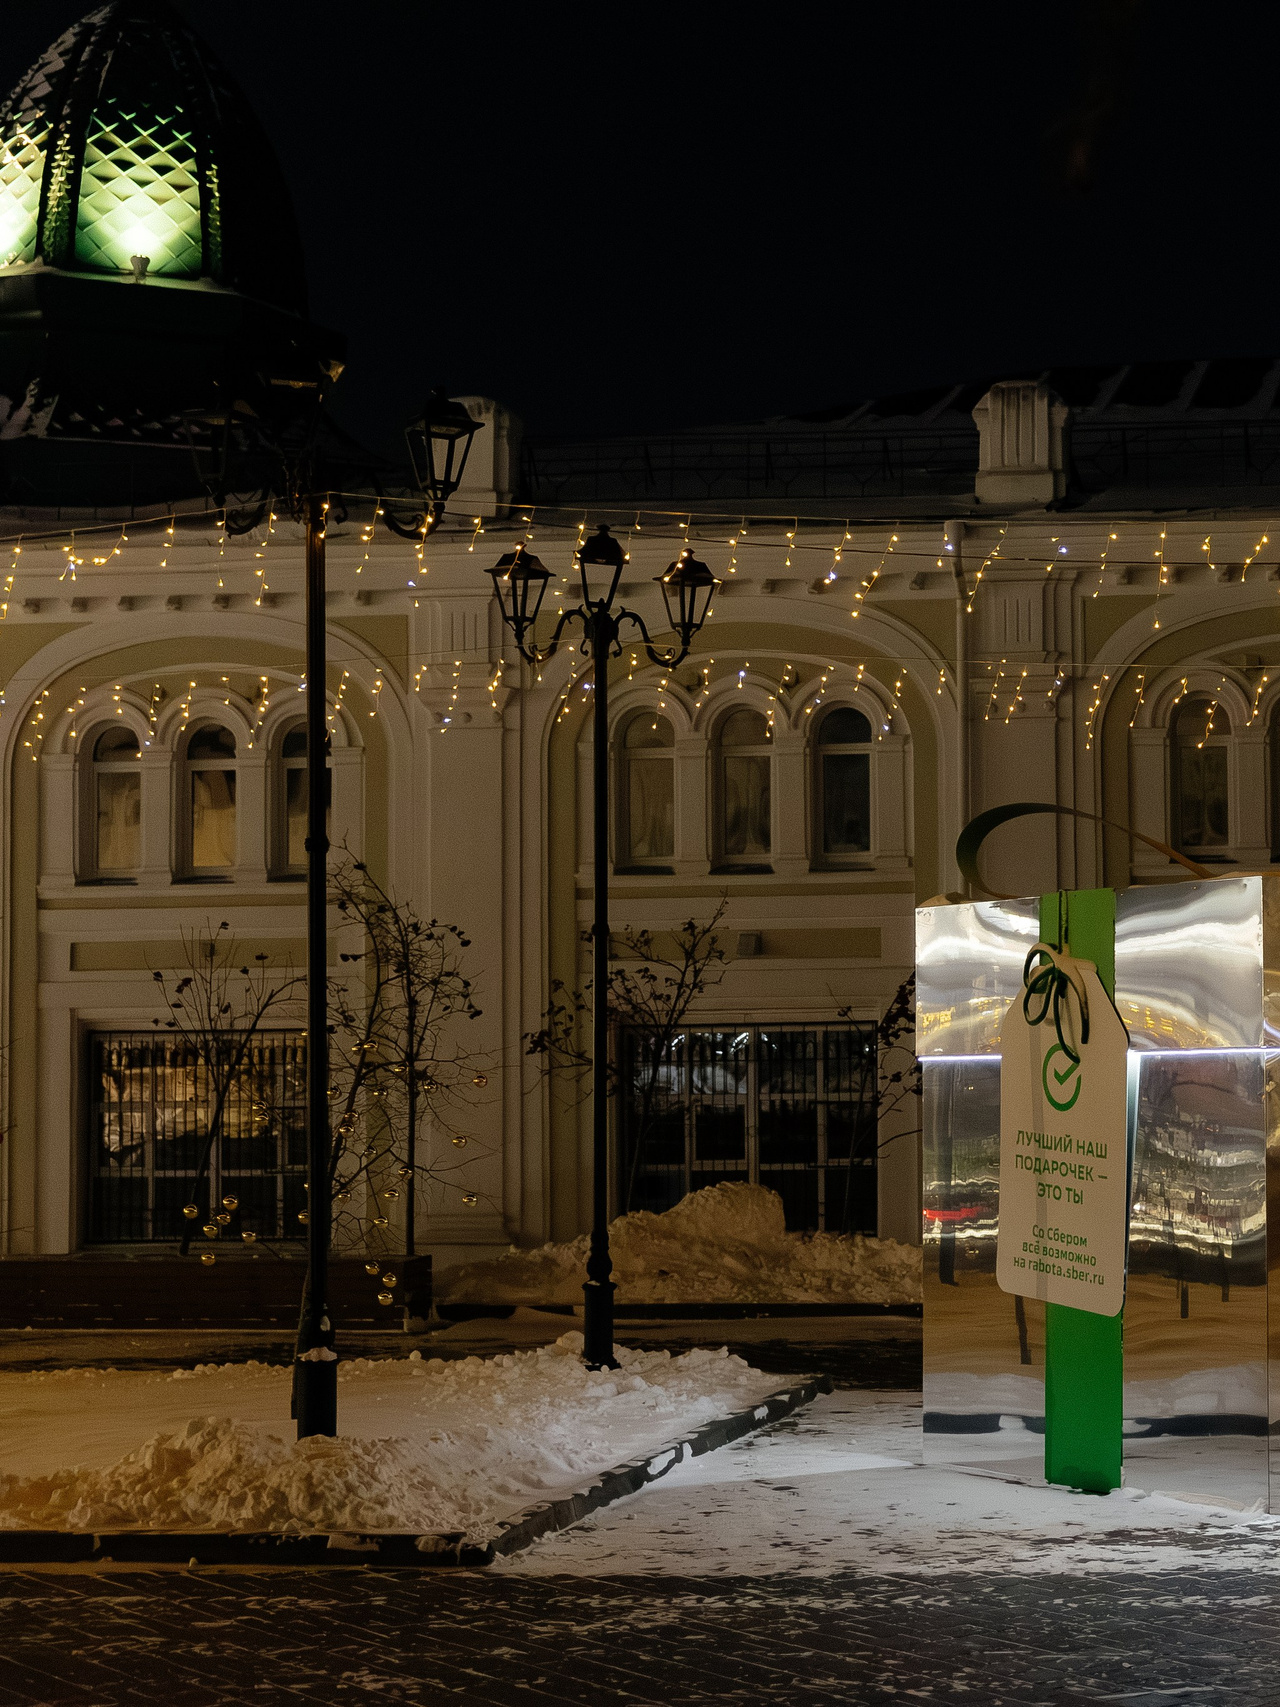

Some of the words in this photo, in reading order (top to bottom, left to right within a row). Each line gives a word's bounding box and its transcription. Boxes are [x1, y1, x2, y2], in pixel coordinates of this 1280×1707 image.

[1016, 1130, 1073, 1153] ЛУЧШИЙ
[1076, 1140, 1108, 1159] НАШ
[1015, 1154, 1094, 1182] ПОДАРОЧЕК
[1037, 1181, 1062, 1201] ЭТО
[1065, 1187, 1084, 1205] ТЫ
[1032, 1224, 1045, 1239] Со
[1047, 1227, 1087, 1247] Сбером
[1022, 1240, 1040, 1255] всё
[1042, 1246, 1097, 1267] возможно
[1013, 1257, 1026, 1269] на
[1028, 1259, 1104, 1285] rabota.sber.ru
